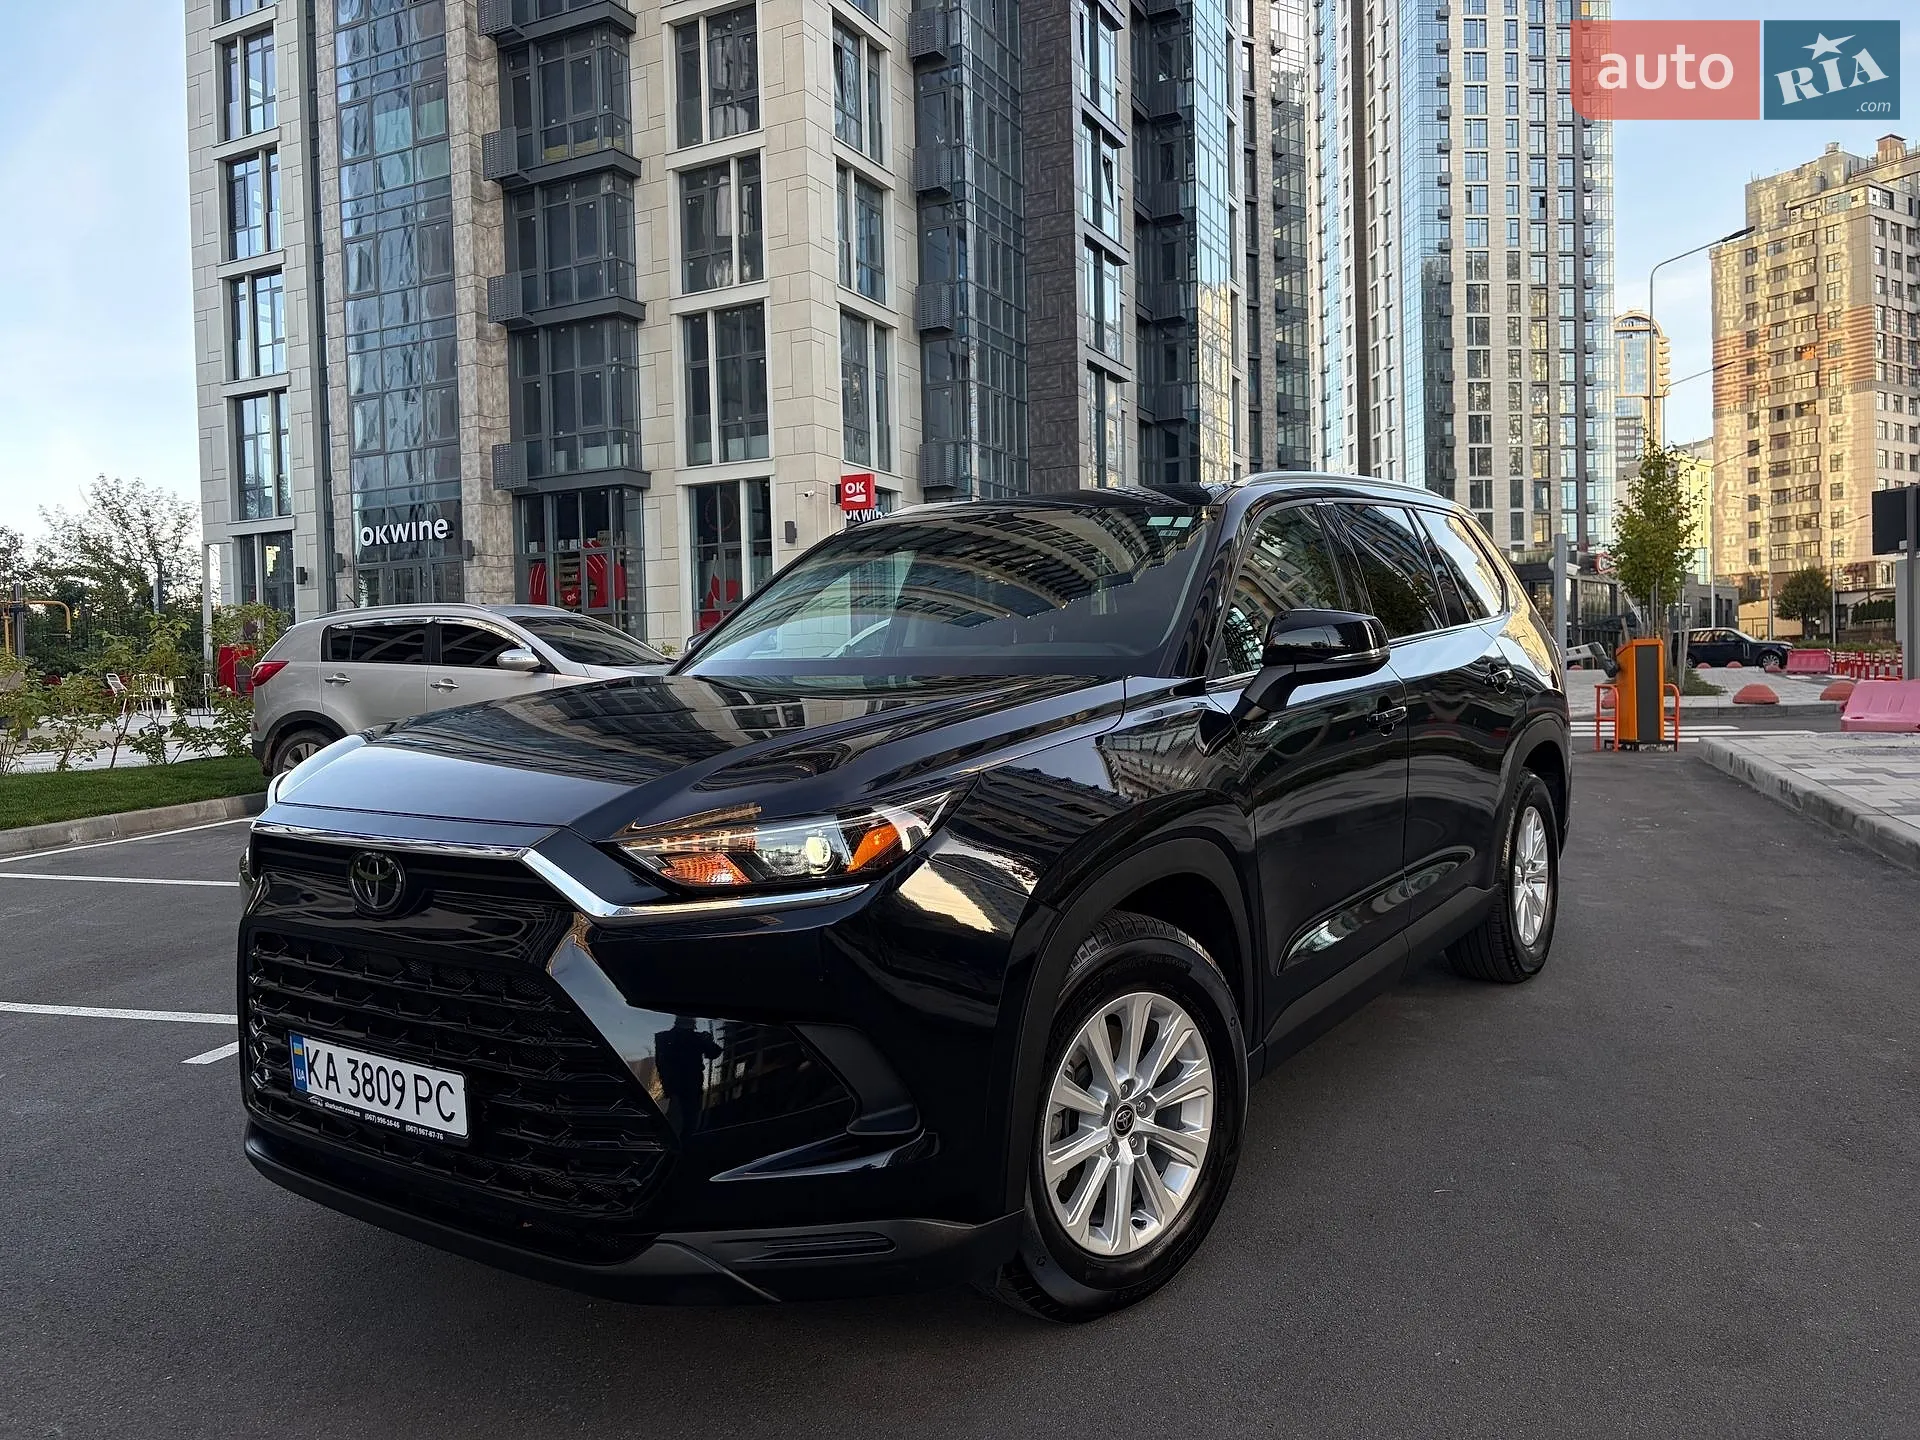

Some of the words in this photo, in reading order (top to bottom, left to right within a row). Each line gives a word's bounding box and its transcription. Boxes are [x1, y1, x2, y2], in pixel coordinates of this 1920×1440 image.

[845, 482, 866, 494] OK
[295, 1067, 306, 1083] UA
[306, 1046, 341, 1094] KA
[347, 1057, 406, 1110] 3809
[414, 1073, 456, 1123] PC
